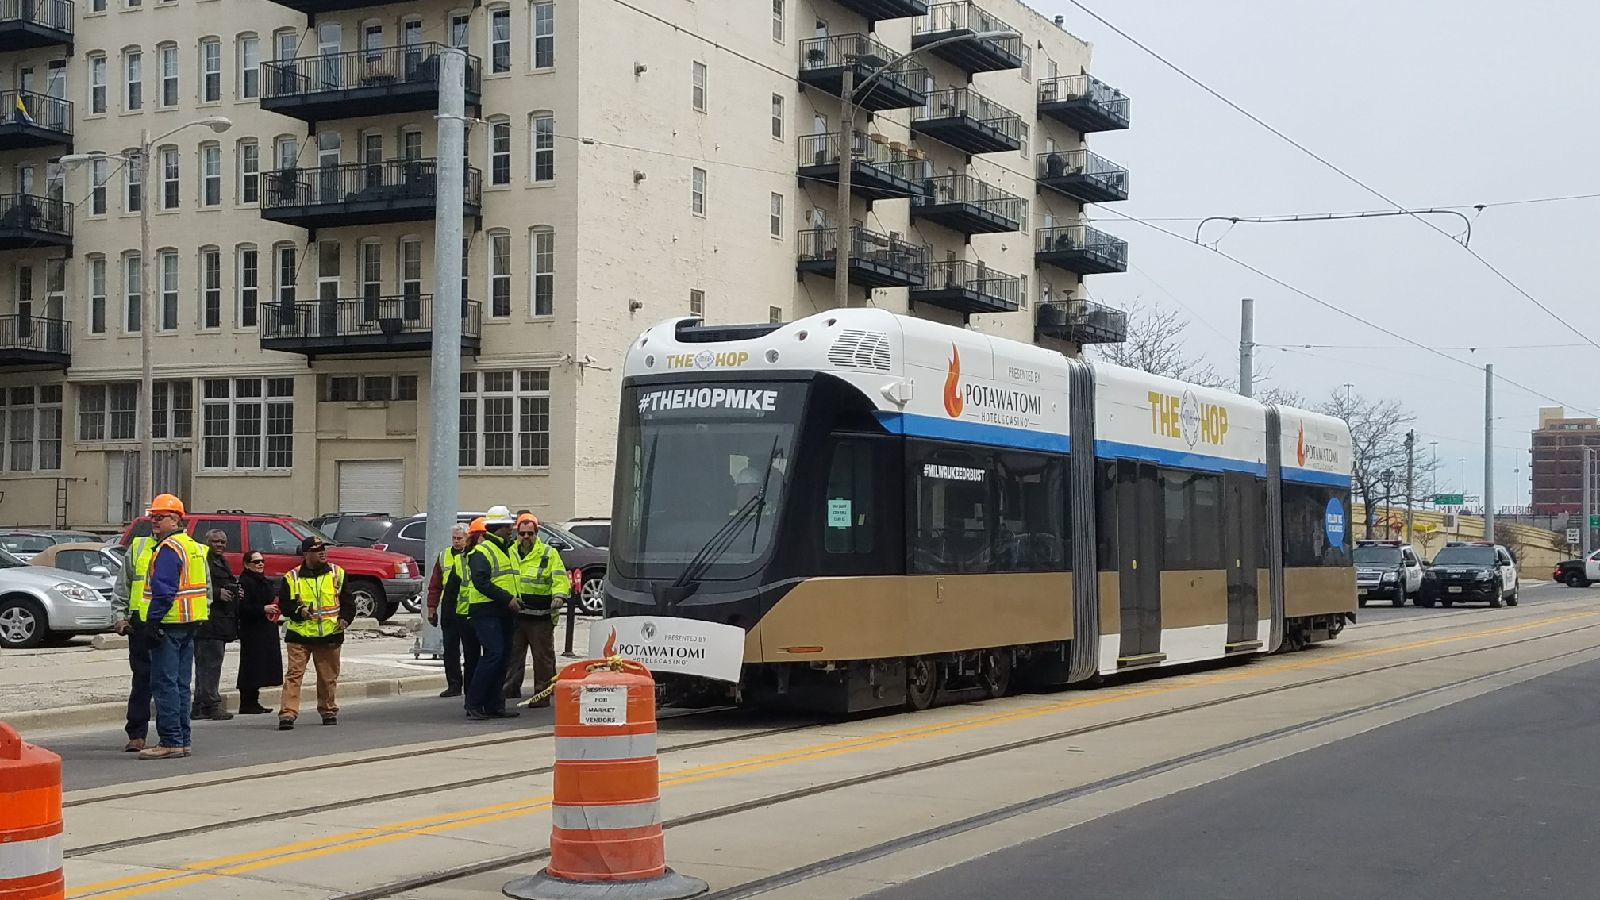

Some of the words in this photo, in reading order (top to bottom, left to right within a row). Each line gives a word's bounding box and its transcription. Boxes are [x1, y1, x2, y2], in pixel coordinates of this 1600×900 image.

[666, 353, 694, 369] THE
[715, 352, 748, 367] HOP
[638, 387, 778, 413] #THEHOPMKE
[965, 383, 1041, 416] POTAWATOMI
[1148, 390, 1180, 438] THE
[1200, 403, 1228, 446] HOP
[1304, 443, 1338, 464] POTAWATOMI
[664, 634, 697, 642] PRESENTED
[618, 643, 705, 659] POTAWATOMI
